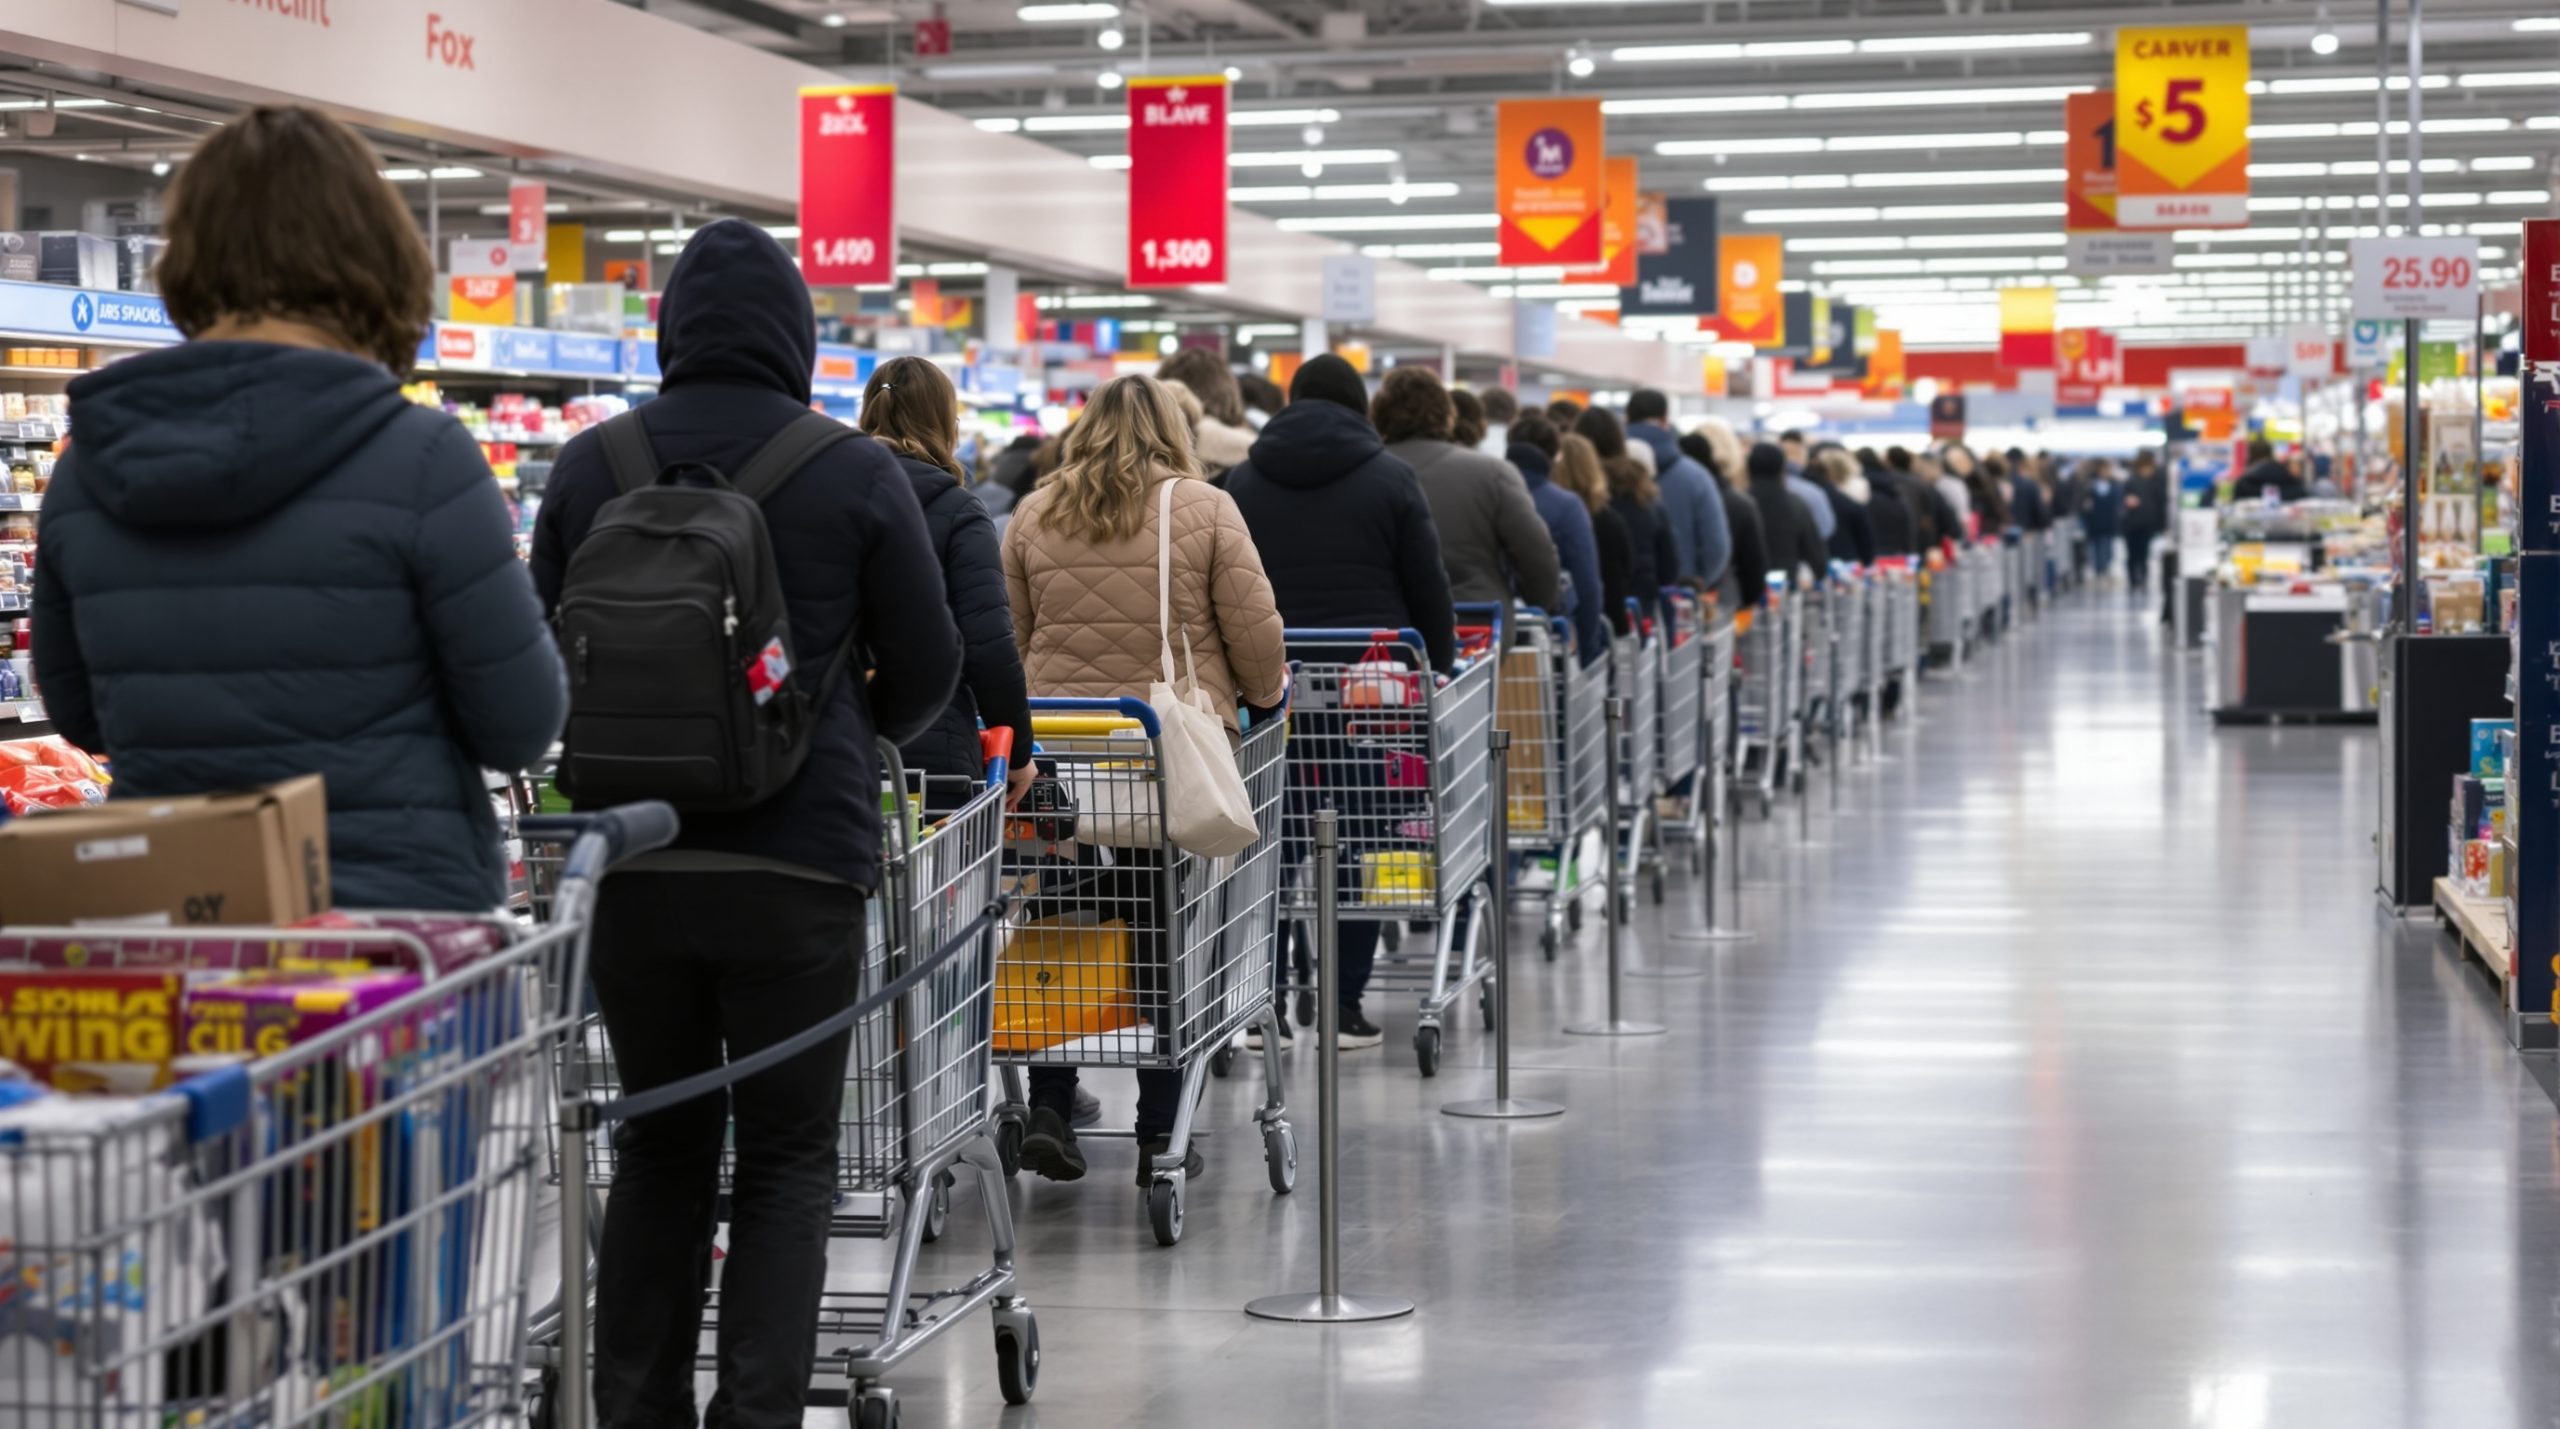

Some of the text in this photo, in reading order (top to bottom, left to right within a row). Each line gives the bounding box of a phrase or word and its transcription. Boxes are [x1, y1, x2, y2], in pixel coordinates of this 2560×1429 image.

[427, 12, 475, 70] Fox
[2133, 39, 2232, 60] CARVER
[1141, 238, 1213, 272] 1,300
[2382, 255, 2472, 290] 25.90
